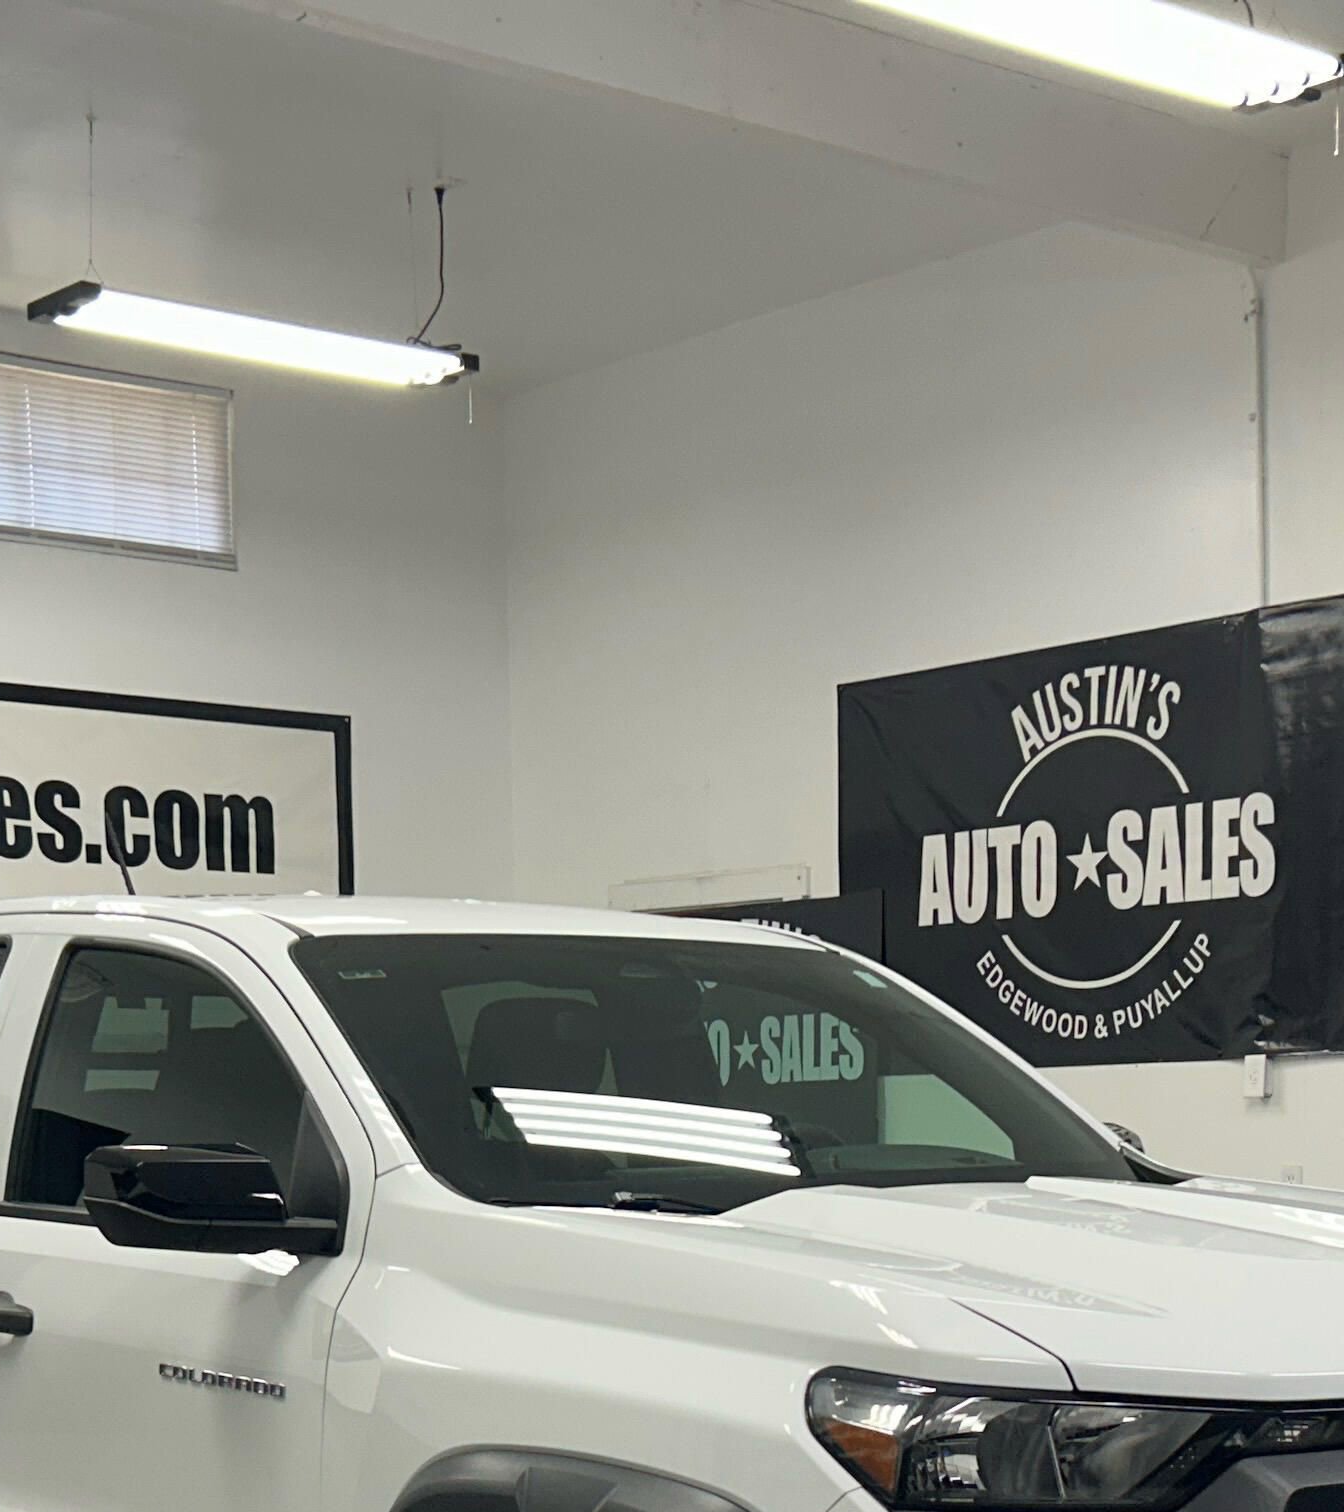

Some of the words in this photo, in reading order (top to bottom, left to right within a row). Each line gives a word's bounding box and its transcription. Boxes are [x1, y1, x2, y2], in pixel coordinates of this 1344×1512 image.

[1011, 665, 1181, 763] AUSTIN'S
[917, 819, 1057, 928] AUTO
[1106, 792, 1277, 910] SALES
[975, 950, 1089, 1040] EDGEWOOD
[1093, 1013, 1109, 1039] &
[1112, 932, 1212, 1036] PUYALLUP
[759, 1012, 865, 1085] SALES
